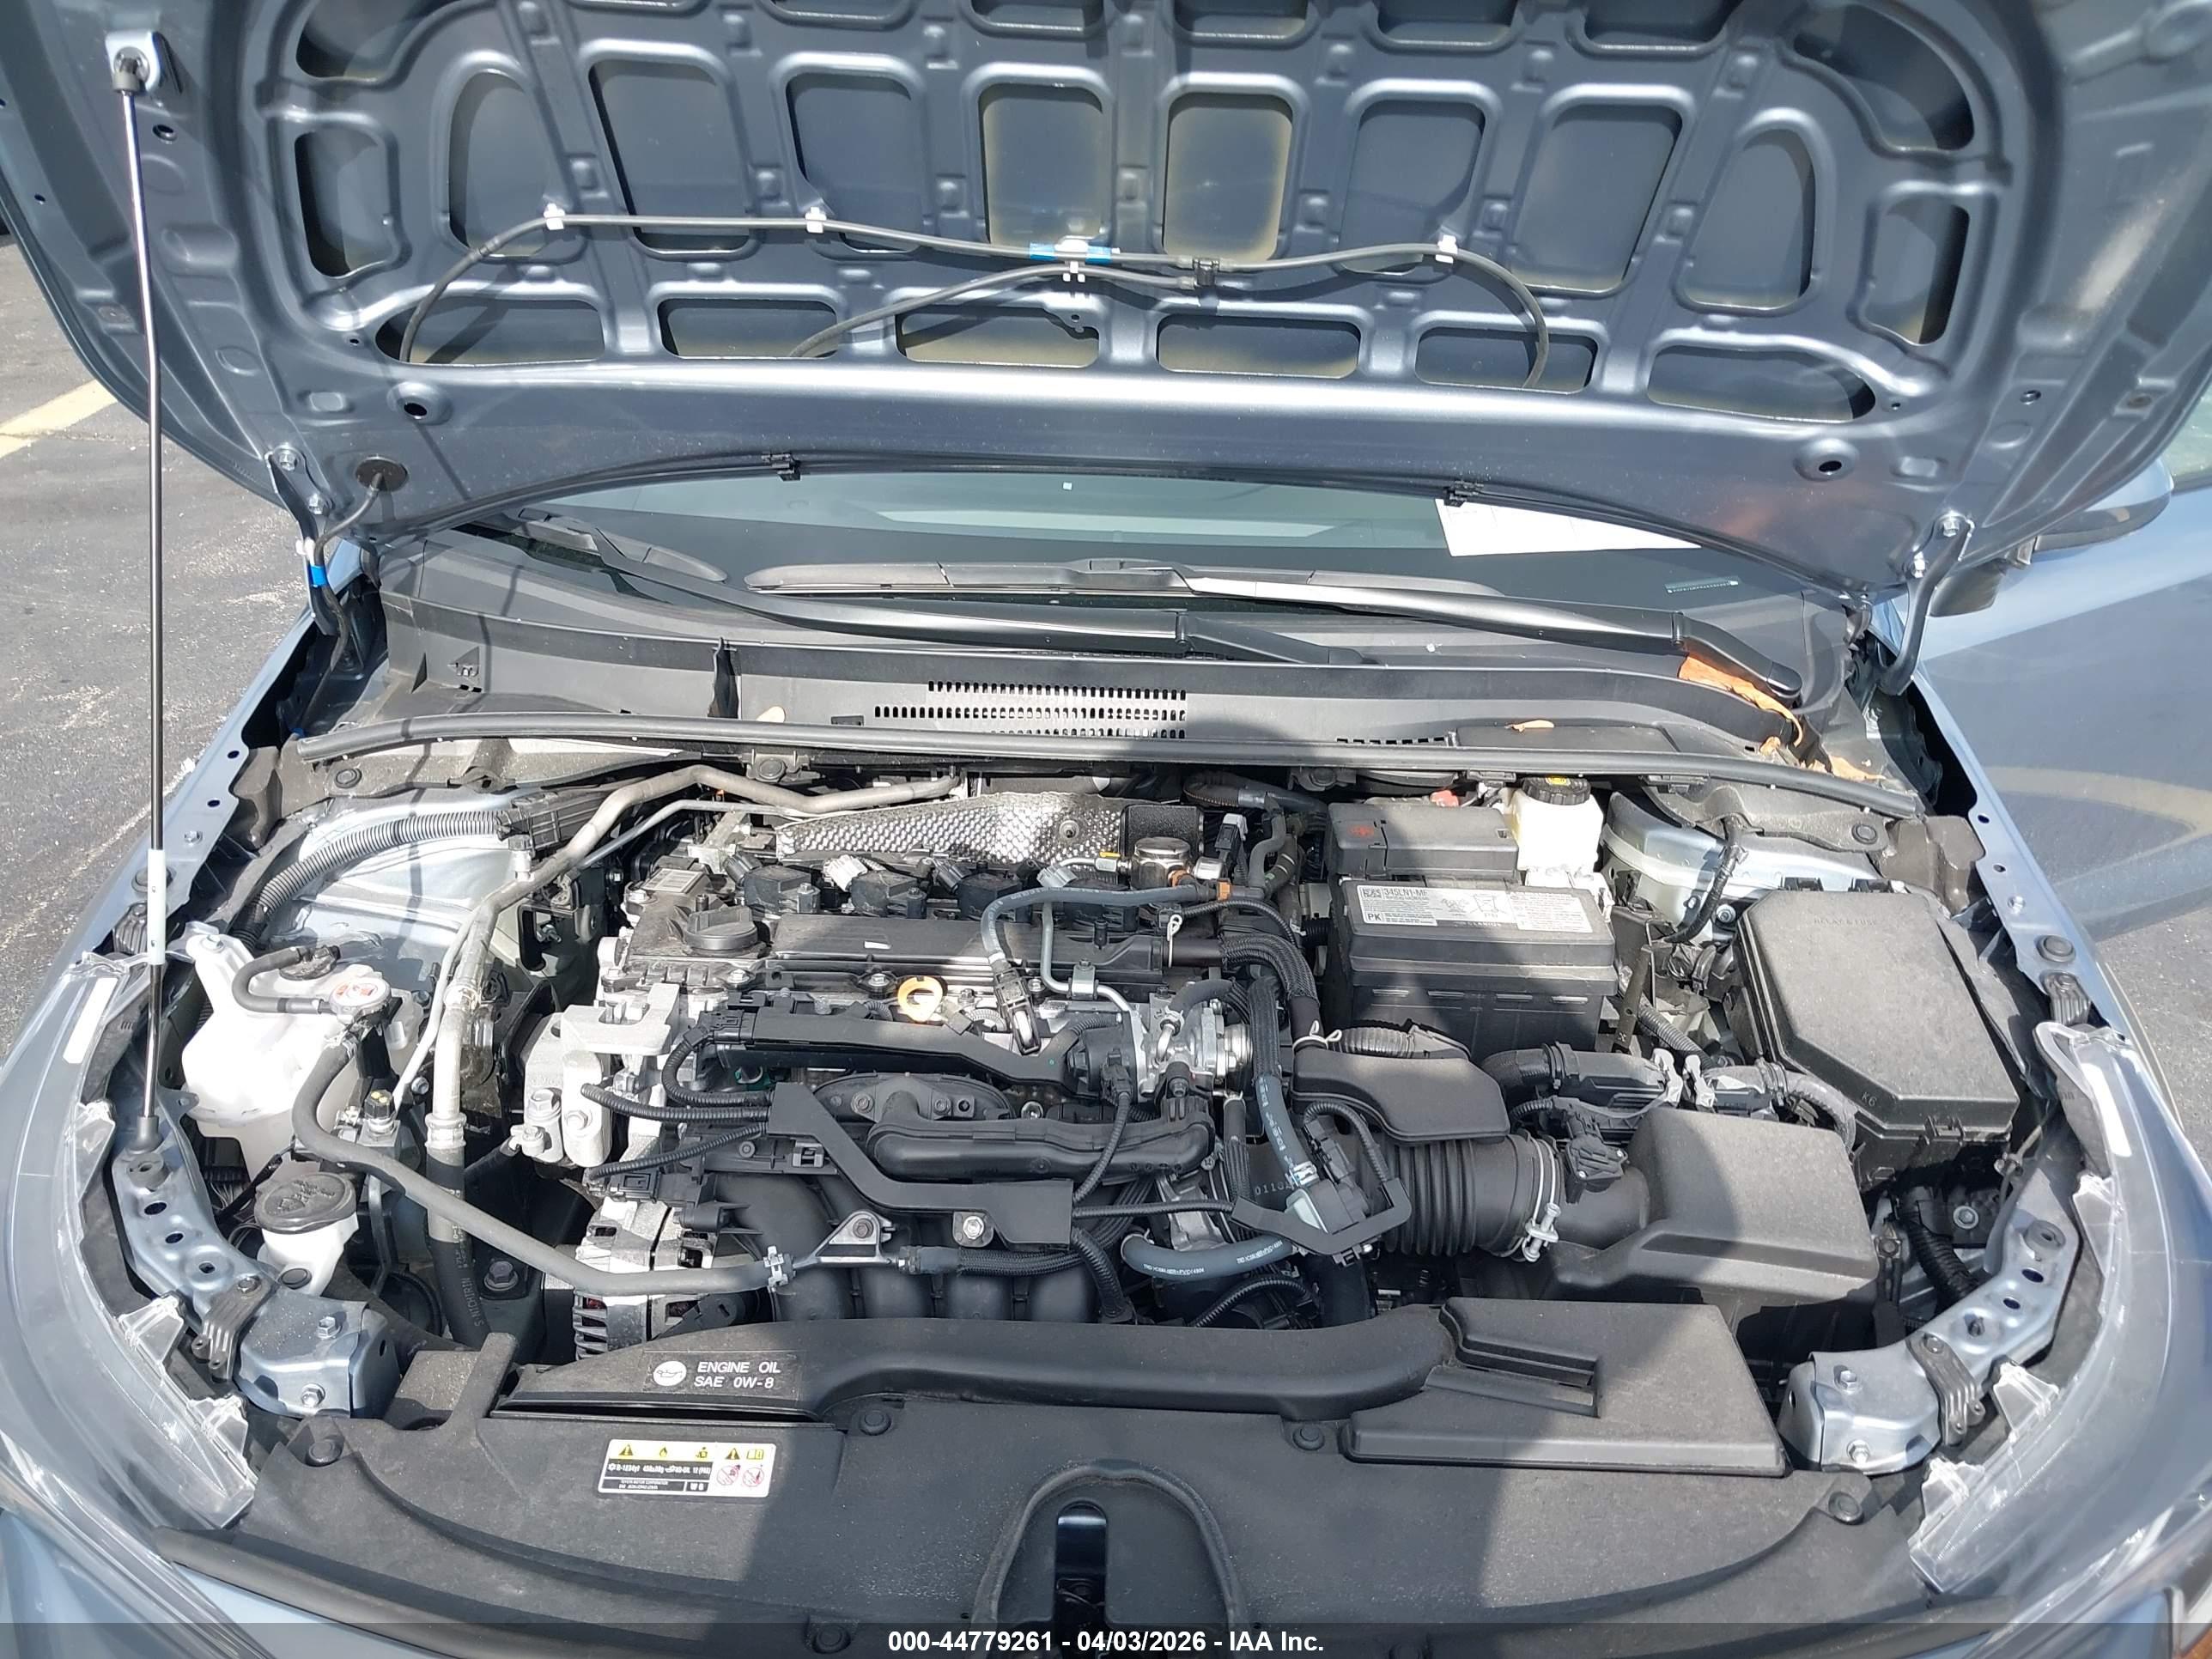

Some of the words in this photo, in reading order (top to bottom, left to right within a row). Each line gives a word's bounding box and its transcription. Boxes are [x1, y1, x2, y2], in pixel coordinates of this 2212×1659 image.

[1367, 913, 1382, 921] PK
[697, 1361, 750, 1373] ENGINE
[758, 1361, 781, 1373] OIL
[694, 1376, 725, 1388] SAE
[733, 1376, 775, 1389] 0W-8
